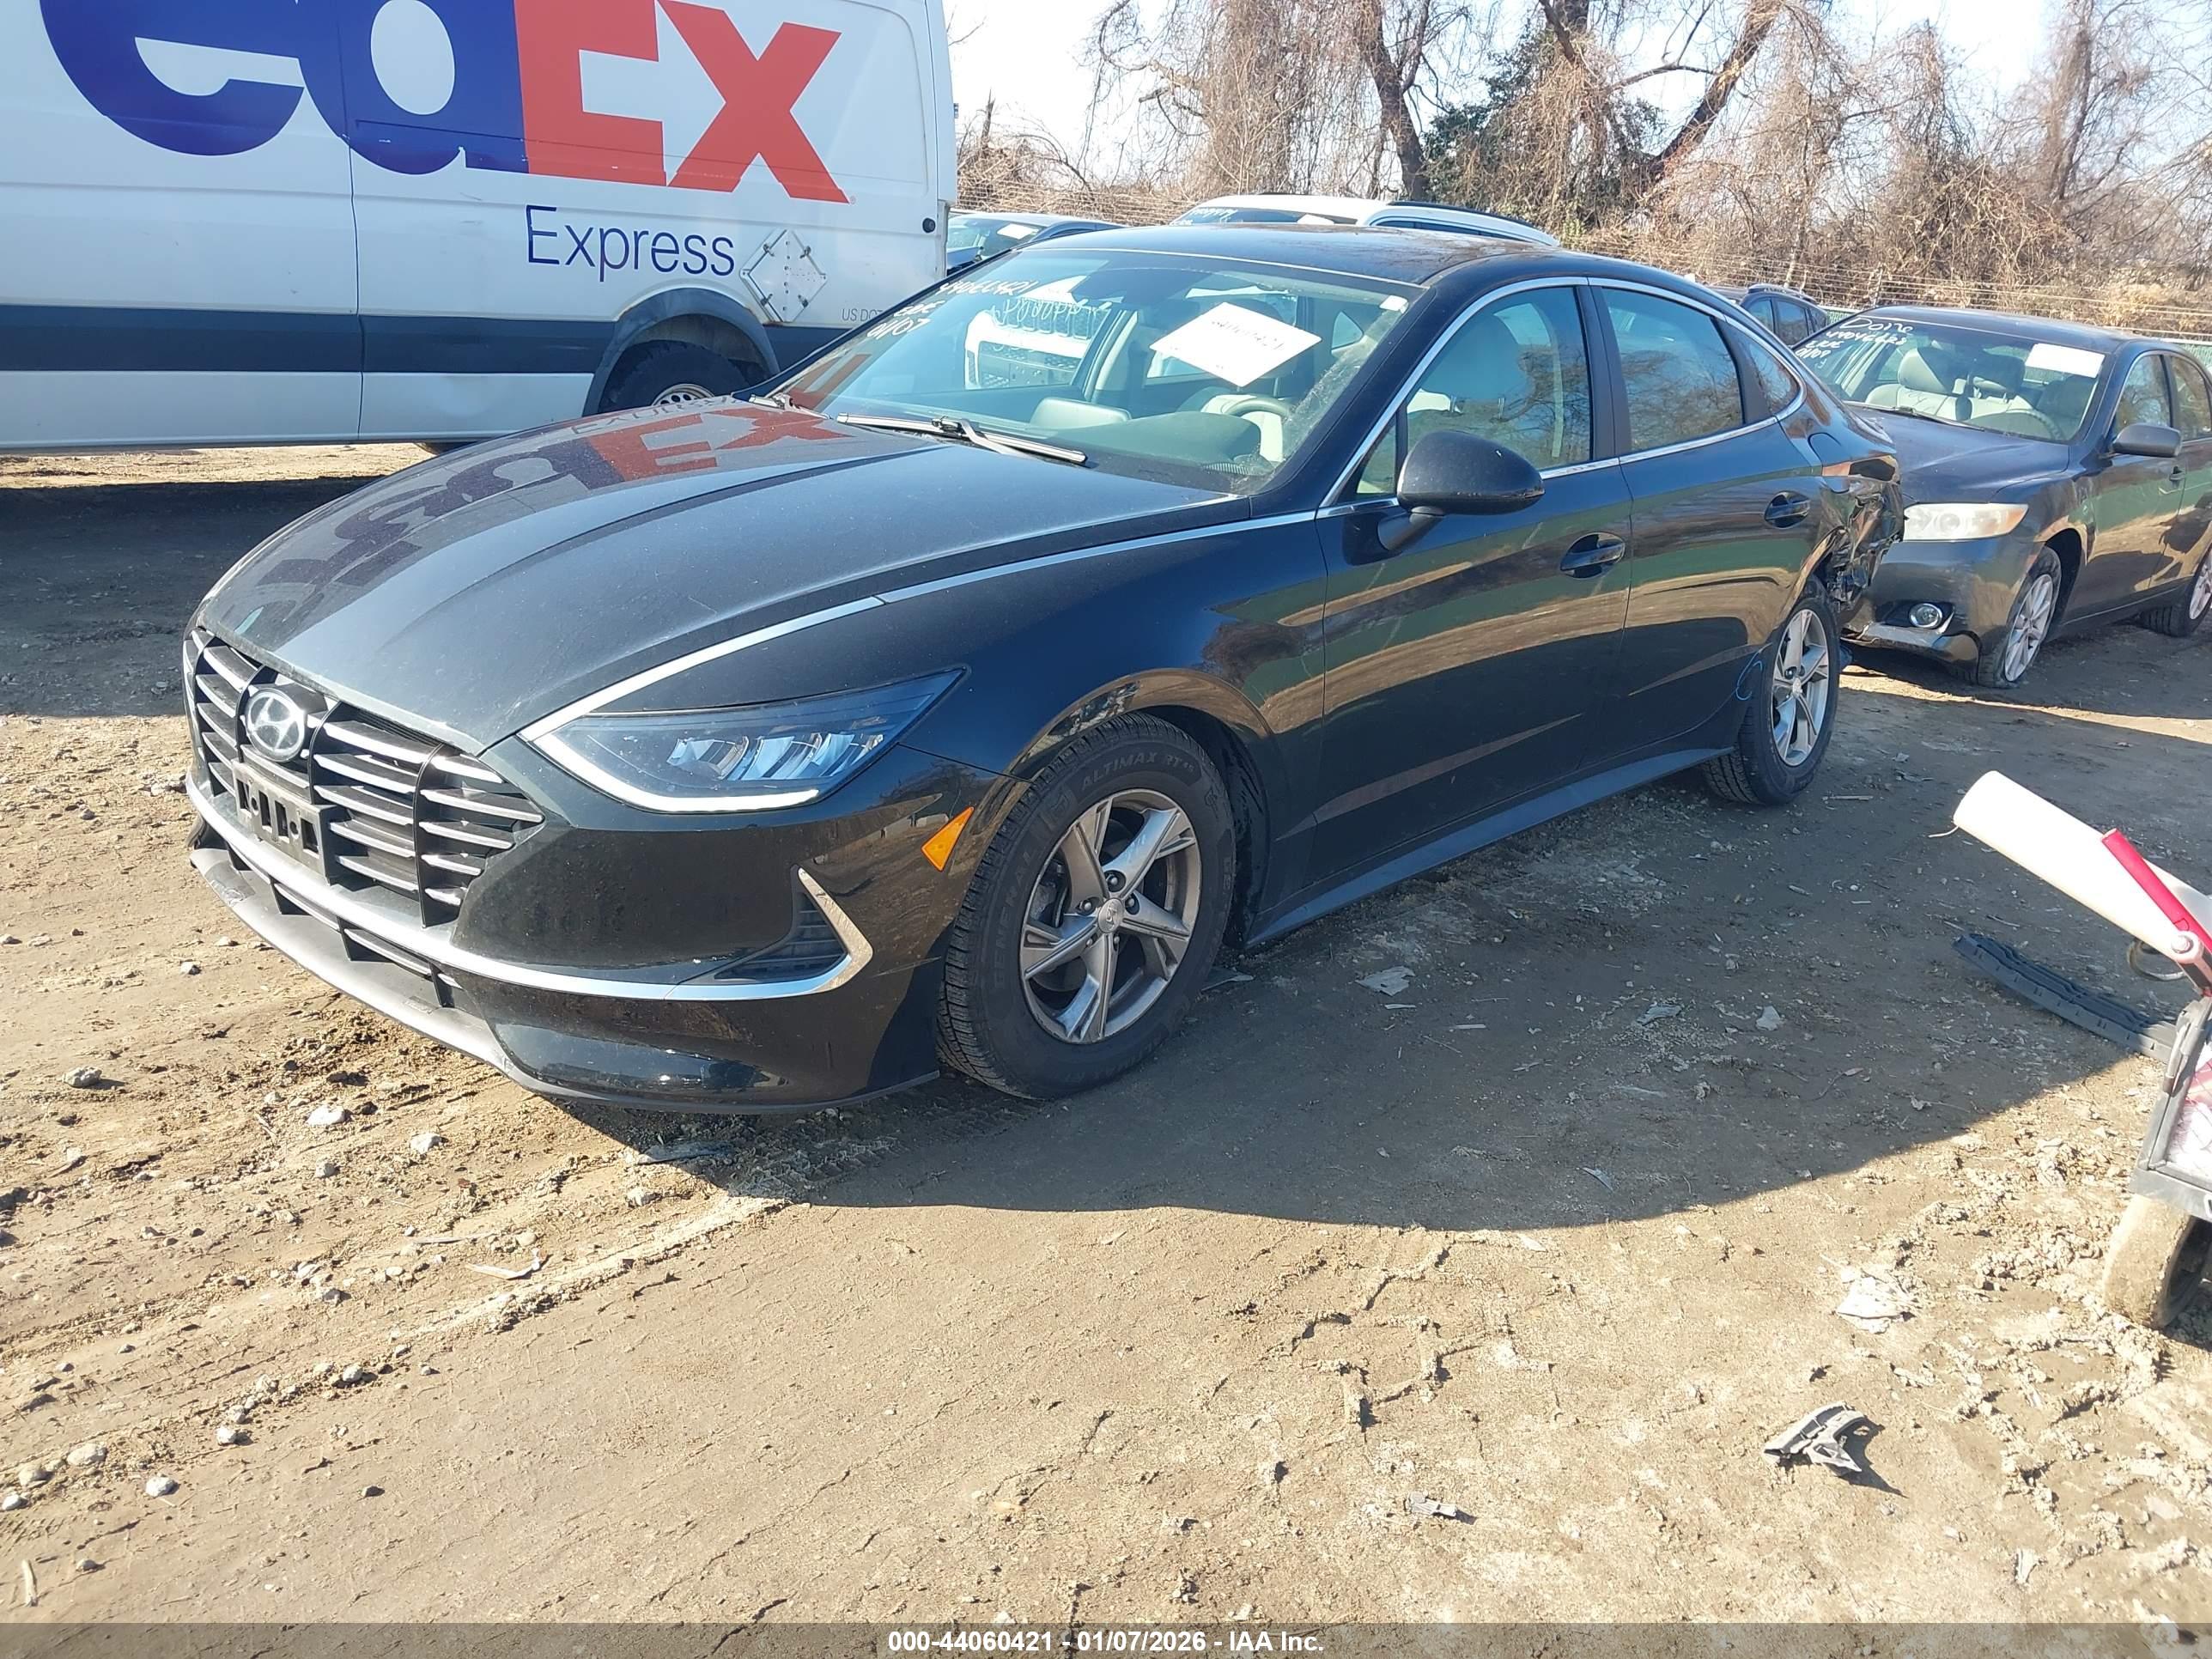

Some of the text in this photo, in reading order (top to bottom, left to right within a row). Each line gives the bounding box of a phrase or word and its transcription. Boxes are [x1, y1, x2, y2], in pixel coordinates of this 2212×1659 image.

[526, 205, 736, 284] Express
[841, 307, 859, 322] US
[1081, 751, 1158, 791] ALTIMAX
